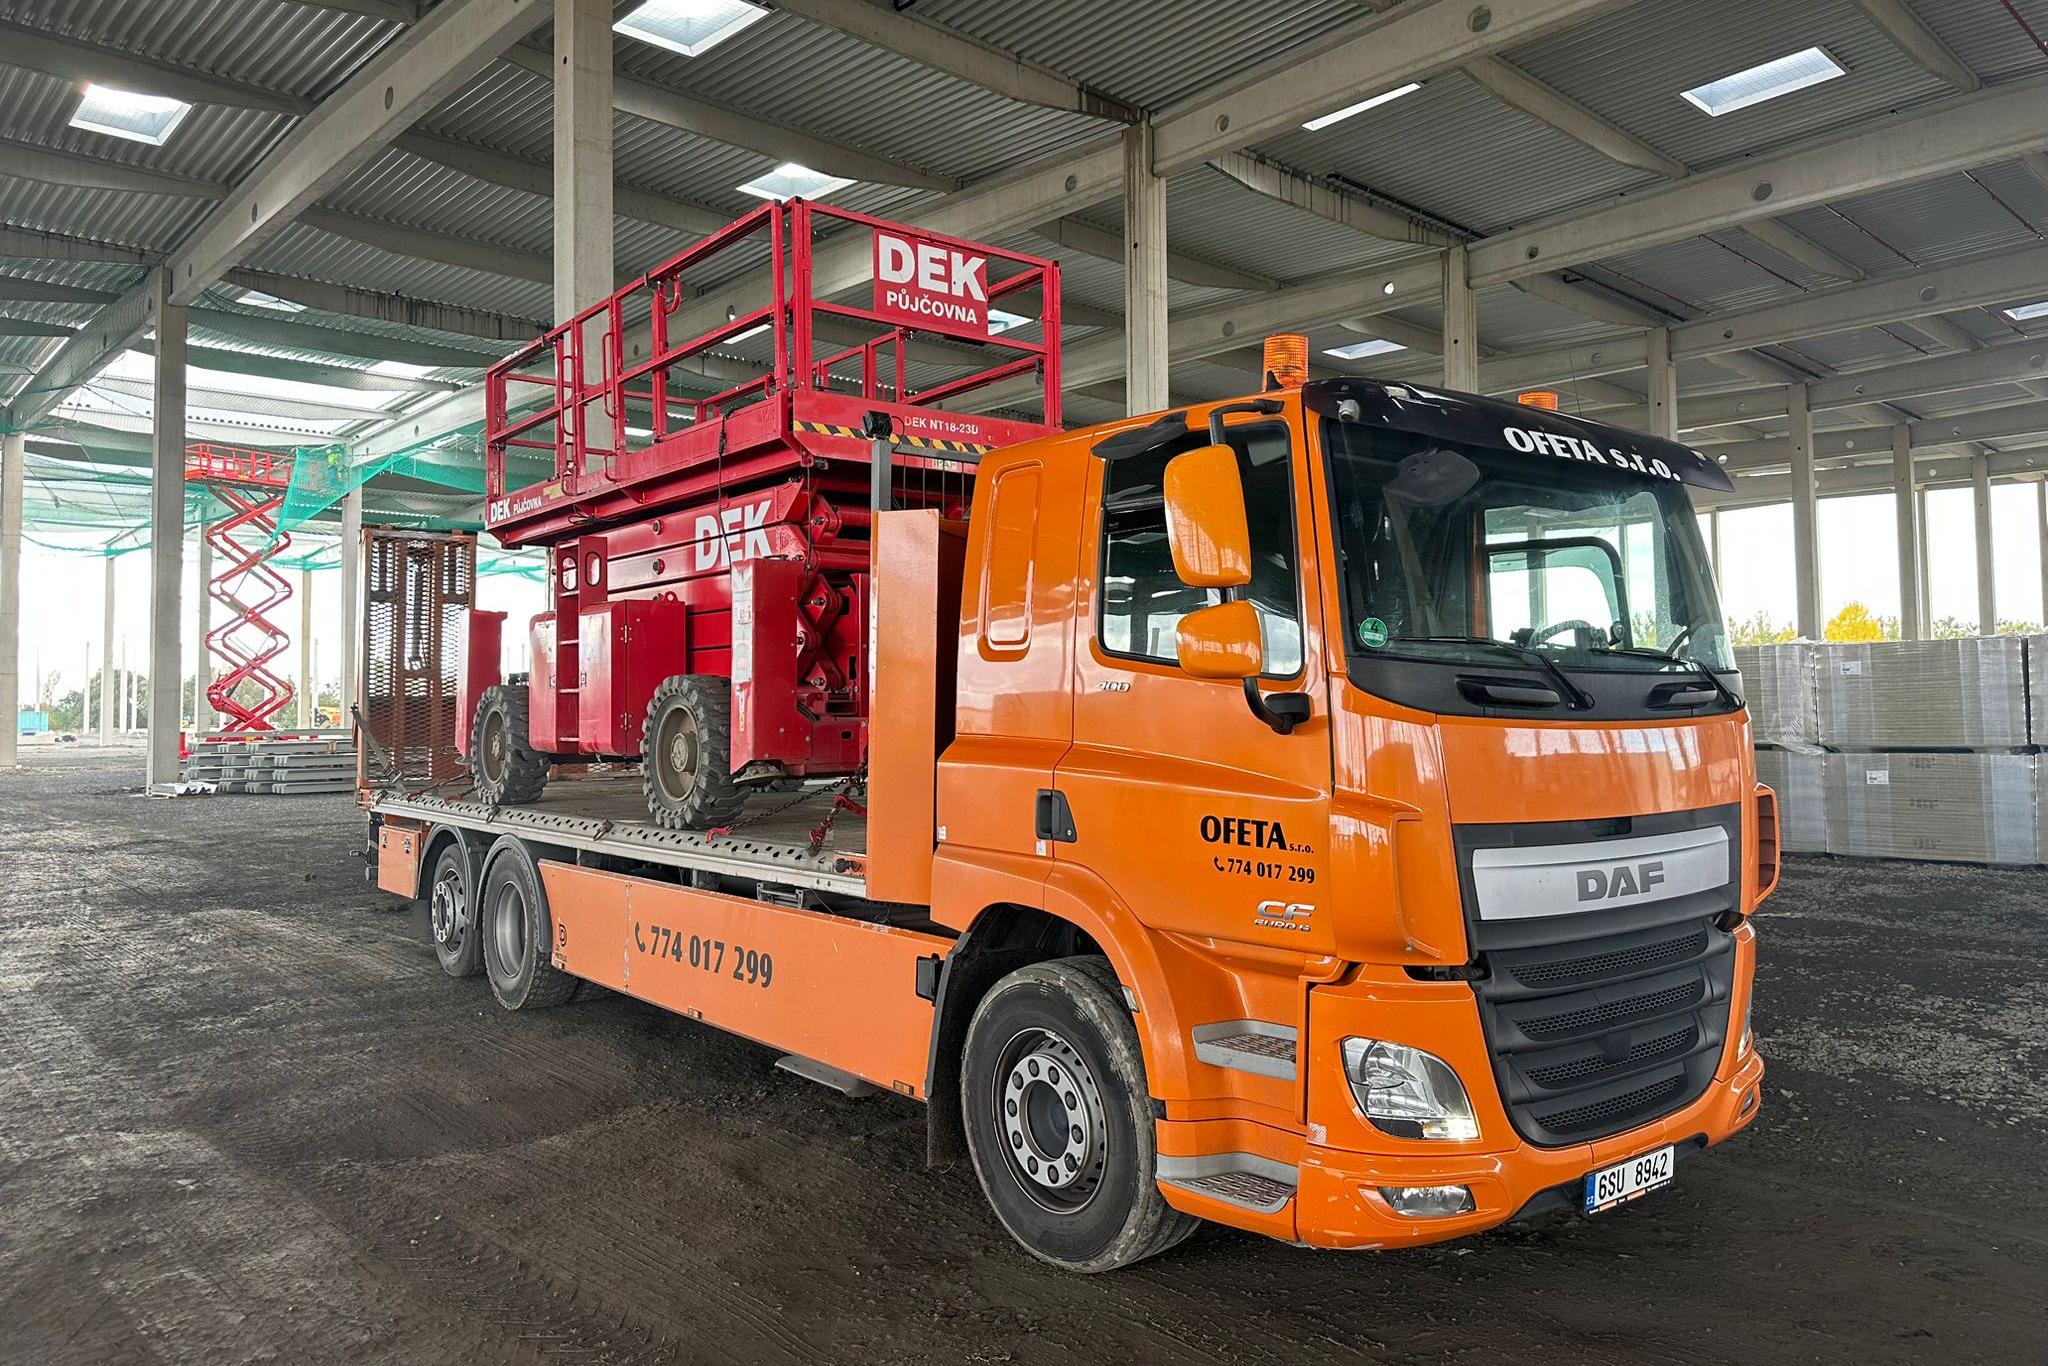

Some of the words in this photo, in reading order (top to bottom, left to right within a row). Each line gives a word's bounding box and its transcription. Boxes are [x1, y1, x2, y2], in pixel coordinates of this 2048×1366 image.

[879, 234, 988, 302] DEK
[886, 288, 978, 324] PŮJČOVNA
[904, 416, 927, 428] DEK
[929, 419, 979, 434] NT18-23D
[1503, 426, 1608, 465] OFETA
[1609, 448, 1681, 481] s.r.o.
[490, 497, 511, 523] DEK
[696, 499, 772, 572] DEK
[1371, 619, 1379, 633] 4
[1096, 680, 1131, 693] 400
[1200, 815, 1288, 851] OFETA
[1289, 843, 1314, 854] s.r.o.
[1227, 858, 1252, 876] 774
[1256, 861, 1282, 880] 017
[1288, 865, 1315, 884] 299
[1576, 861, 1665, 902] DAF
[1257, 900, 1316, 921] CF
[651, 925, 682, 963] 774
[689, 935, 725, 974] 017
[733, 945, 773, 989] 299
[1598, 1167, 1625, 1200] 6SU
[1635, 1152, 1668, 1187] 8942
